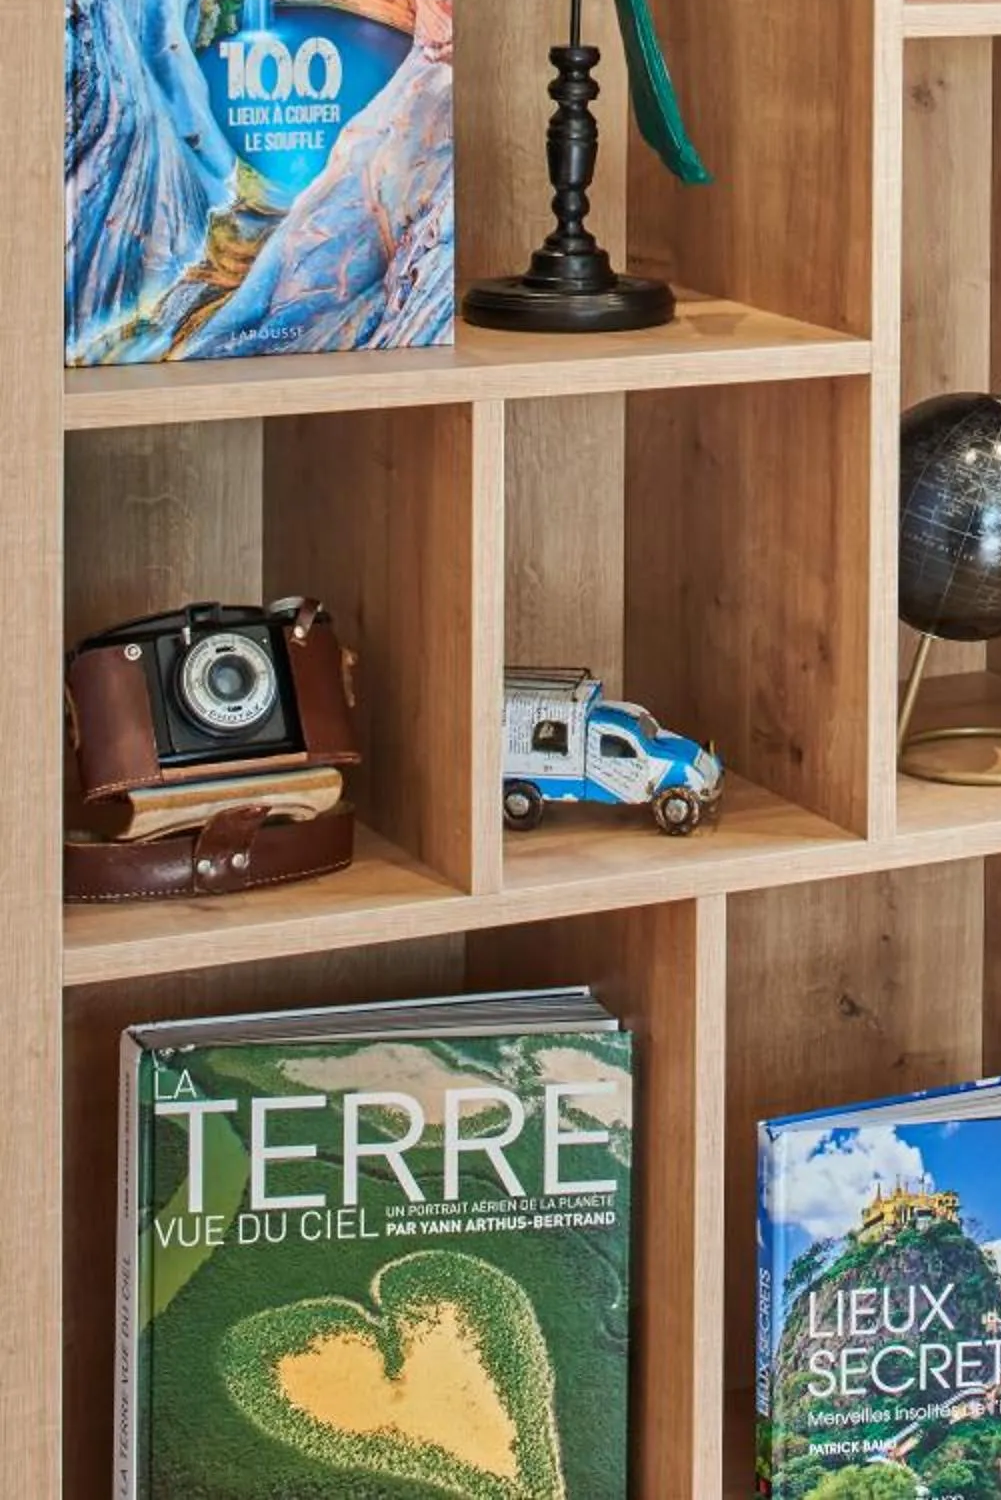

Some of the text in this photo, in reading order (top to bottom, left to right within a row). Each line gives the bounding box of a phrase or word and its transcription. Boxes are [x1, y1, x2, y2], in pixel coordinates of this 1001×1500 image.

[219, 37, 342, 101] 100
[228, 100, 341, 127] LIEUX À COUPER
[245, 129, 326, 153] LE SOUFFLE
[231, 325, 305, 341] LAROUSSE
[154, 1069, 197, 1100] LA
[154, 1081, 618, 1213] TERRE
[385, 1206, 405, 1218] UN
[408, 1201, 469, 1217] PORTRAIT
[519, 1198, 537, 1212] DE
[540, 1196, 557, 1210] LA
[154, 1207, 380, 1249] VUE DU CIEL
[386, 1211, 616, 1237] PAR YANN ARTHUS-BERTRAND
[808, 1283, 955, 1339] LIEUX
[755, 1267, 772, 1417] LIEUX SECRETS
[119, 1252, 132, 1497] LA TERRE VUE DU CIEL
[808, 1408, 891, 1427] Merveilles
[809, 1441, 860, 1455] PATRICK
